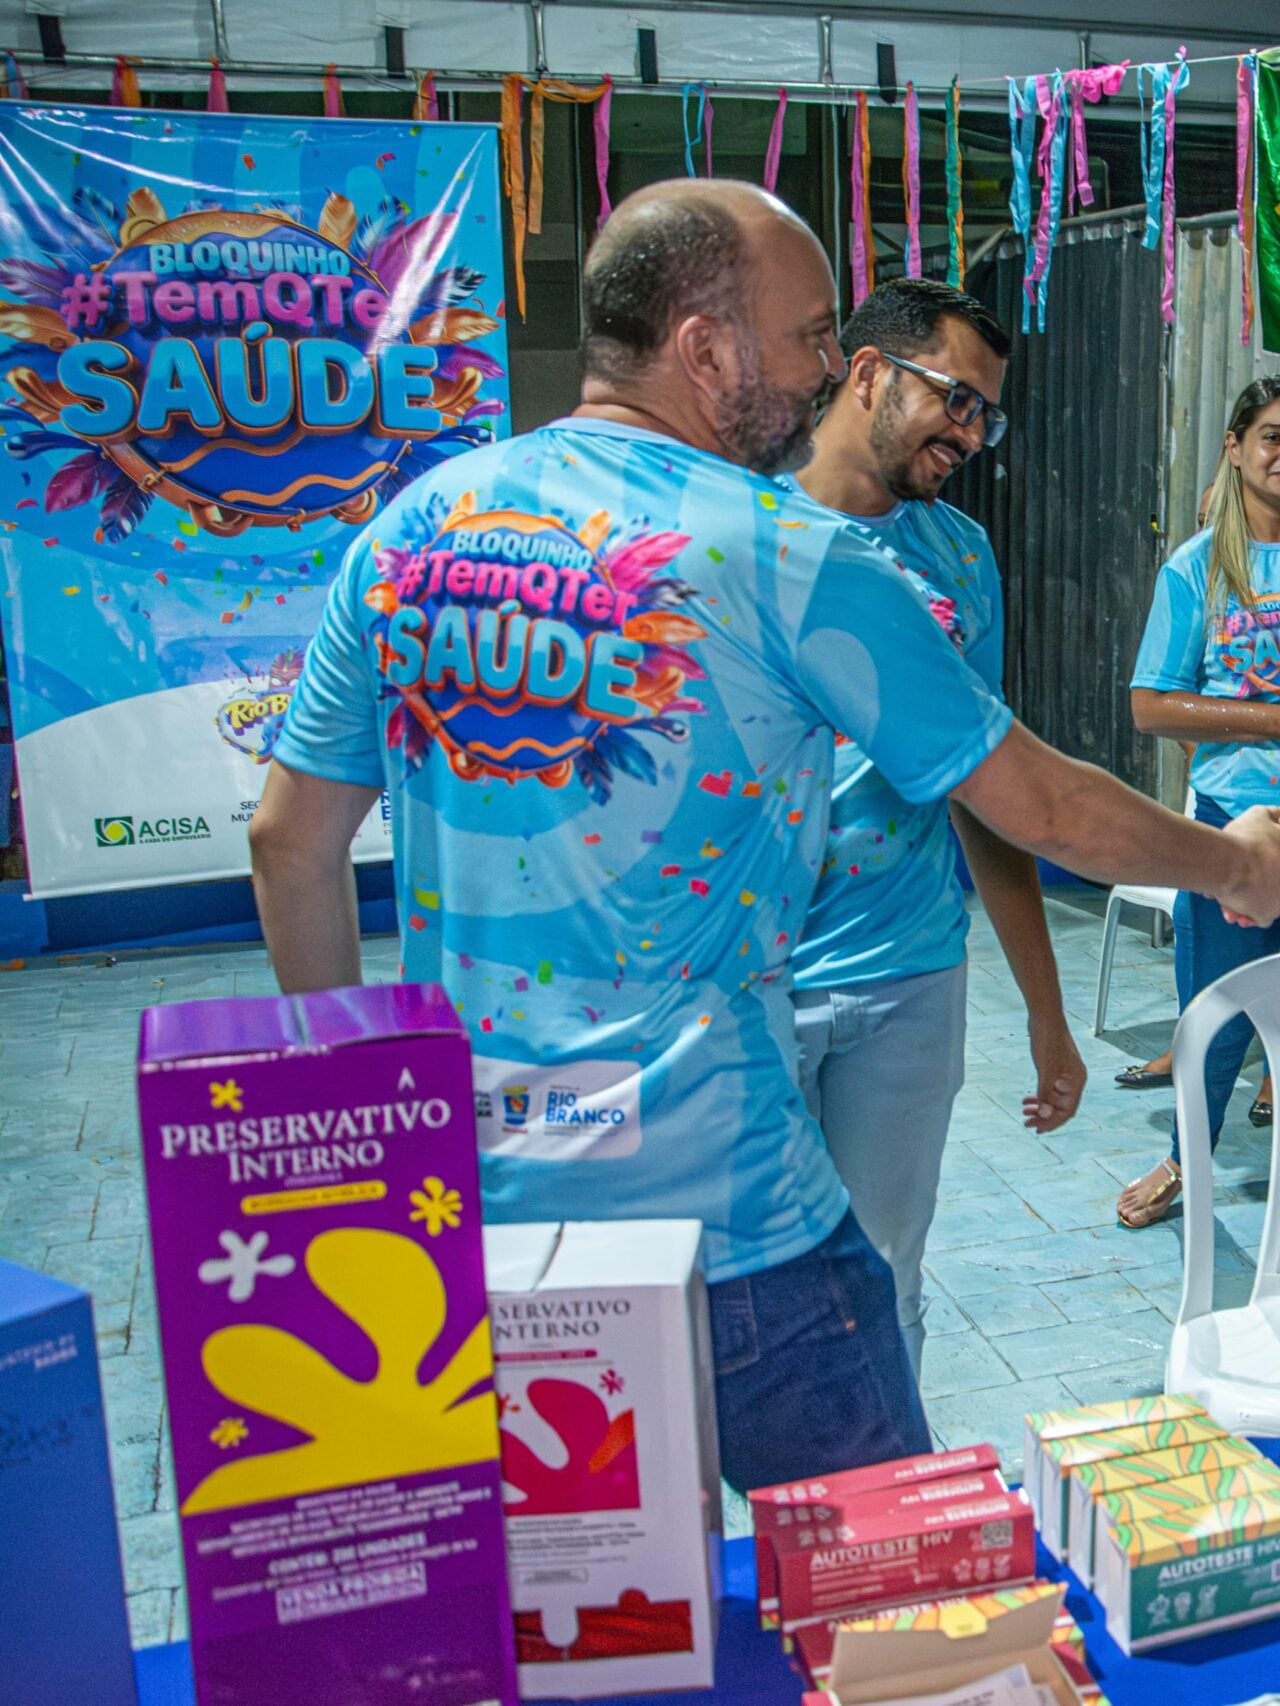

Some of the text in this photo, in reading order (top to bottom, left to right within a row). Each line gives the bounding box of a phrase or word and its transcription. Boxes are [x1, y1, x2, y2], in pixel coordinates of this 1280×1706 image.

[150, 242, 350, 278] BLOQUINHO
[60, 271, 398, 331] #TemQTe
[57, 321, 443, 438] SAÚDE
[452, 530, 593, 573] BLOQUINHO
[398, 549, 639, 626] #TemQTer
[387, 600, 645, 722] SAÚDE
[139, 816, 210, 837] ACISA
[545, 1106, 625, 1125] BRANCO
[548, 1091, 577, 1107] RIO
[160, 1099, 451, 1159] PRESERVATIVO
[228, 1140, 384, 1183] INTERNO
[811, 1530, 953, 1571] AUTOTESTE HIV
[1157, 1545, 1253, 1581] AUTOTESTE
